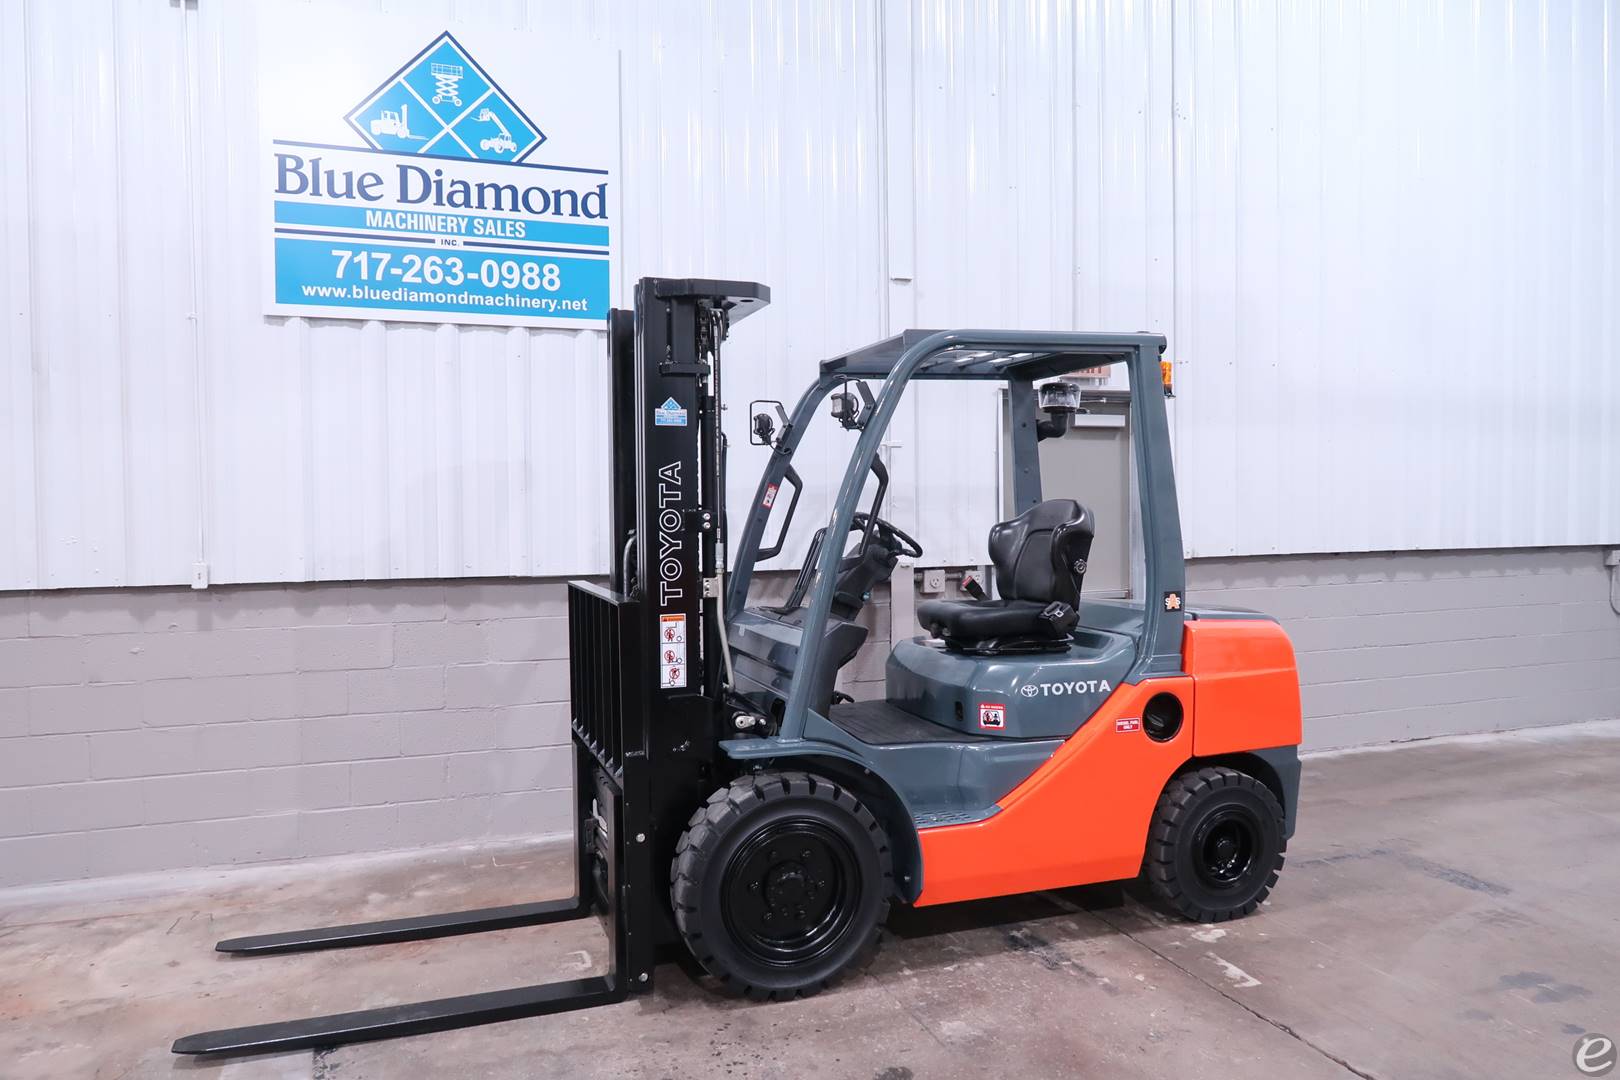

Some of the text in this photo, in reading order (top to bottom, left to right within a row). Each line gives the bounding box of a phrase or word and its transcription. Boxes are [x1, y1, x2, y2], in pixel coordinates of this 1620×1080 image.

[274, 153, 608, 219] Blue Diamond
[366, 210, 526, 238] MACHINERY SALES
[440, 238, 461, 247] INC.
[331, 250, 561, 291] 717-263-0988
[302, 284, 588, 312] www.bluediamondmachinery.net
[659, 461, 683, 606] TOYOTA
[1040, 679, 1111, 697] TOYOTA
